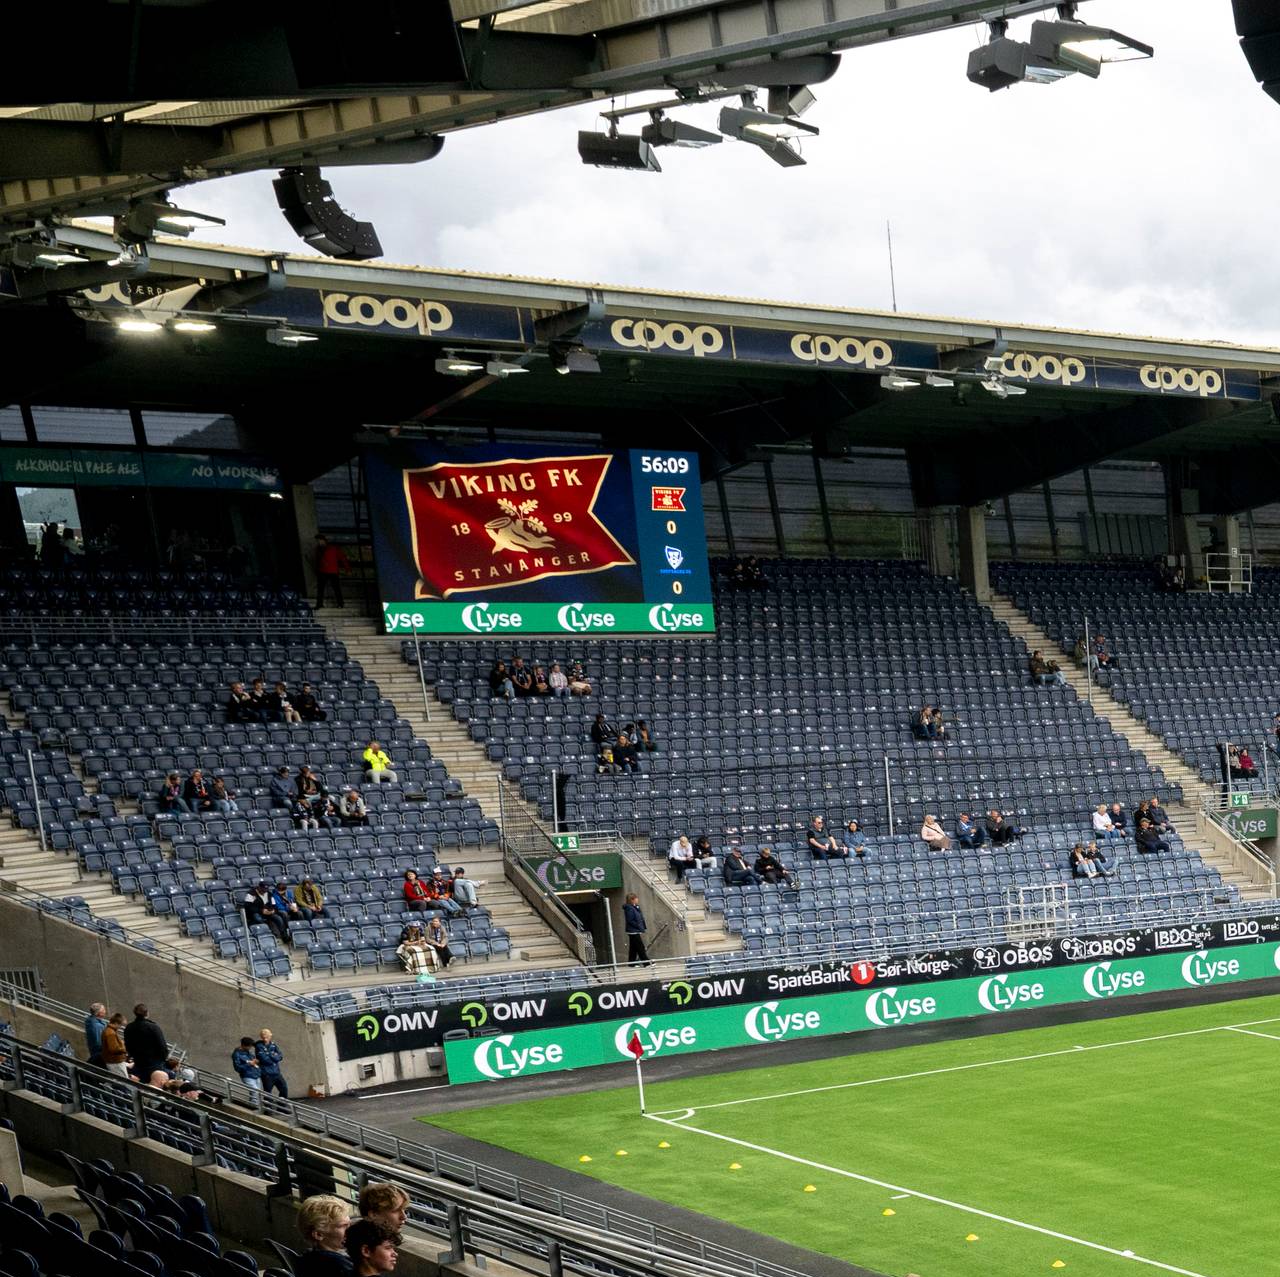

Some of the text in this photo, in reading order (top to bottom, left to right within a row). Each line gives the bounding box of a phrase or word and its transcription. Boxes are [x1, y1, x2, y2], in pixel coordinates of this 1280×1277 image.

[324, 293, 453, 336] coop
[611, 318, 723, 356] coop
[790, 333, 893, 369] coop
[1000, 351, 1087, 386] coop
[1139, 363, 1223, 397] coop
[86, 461, 115, 475] PALE
[118, 464, 141, 476] ALE
[192, 465, 214, 478] NO
[641, 456, 689, 474] 56:09
[428, 468, 583, 500] VIKING FK
[552, 511, 573, 524] 99
[666, 520, 677, 535] 0
[450, 522, 471, 537] 18
[454, 551, 590, 582] STAVANGER
[672, 581, 683, 595] 0
[476, 610, 522, 632] Lyse
[571, 610, 615, 631] Lyse
[661, 610, 704, 632] Lyse
[553, 862, 605, 889] Lyse
[1229, 920, 1259, 936] BDO
[1003, 945, 1053, 965] OBOS
[1088, 938, 1134, 957] OBOS
[767, 967, 851, 992] SpareBank
[877, 957, 950, 978] Sør-Norge
[1196, 958, 1240, 984] Lyse
[698, 978, 746, 999] OMV
[1098, 970, 1145, 996] Lyse
[598, 988, 649, 1009] OMV
[994, 982, 1044, 1009] Lyse
[383, 1010, 438, 1033] OMV
[493, 999, 546, 1021] OMV
[883, 996, 936, 1024] Lyse
[763, 1010, 820, 1039] Lyse
[634, 1026, 697, 1056] Lyse
[495, 1043, 563, 1076] Lyse
